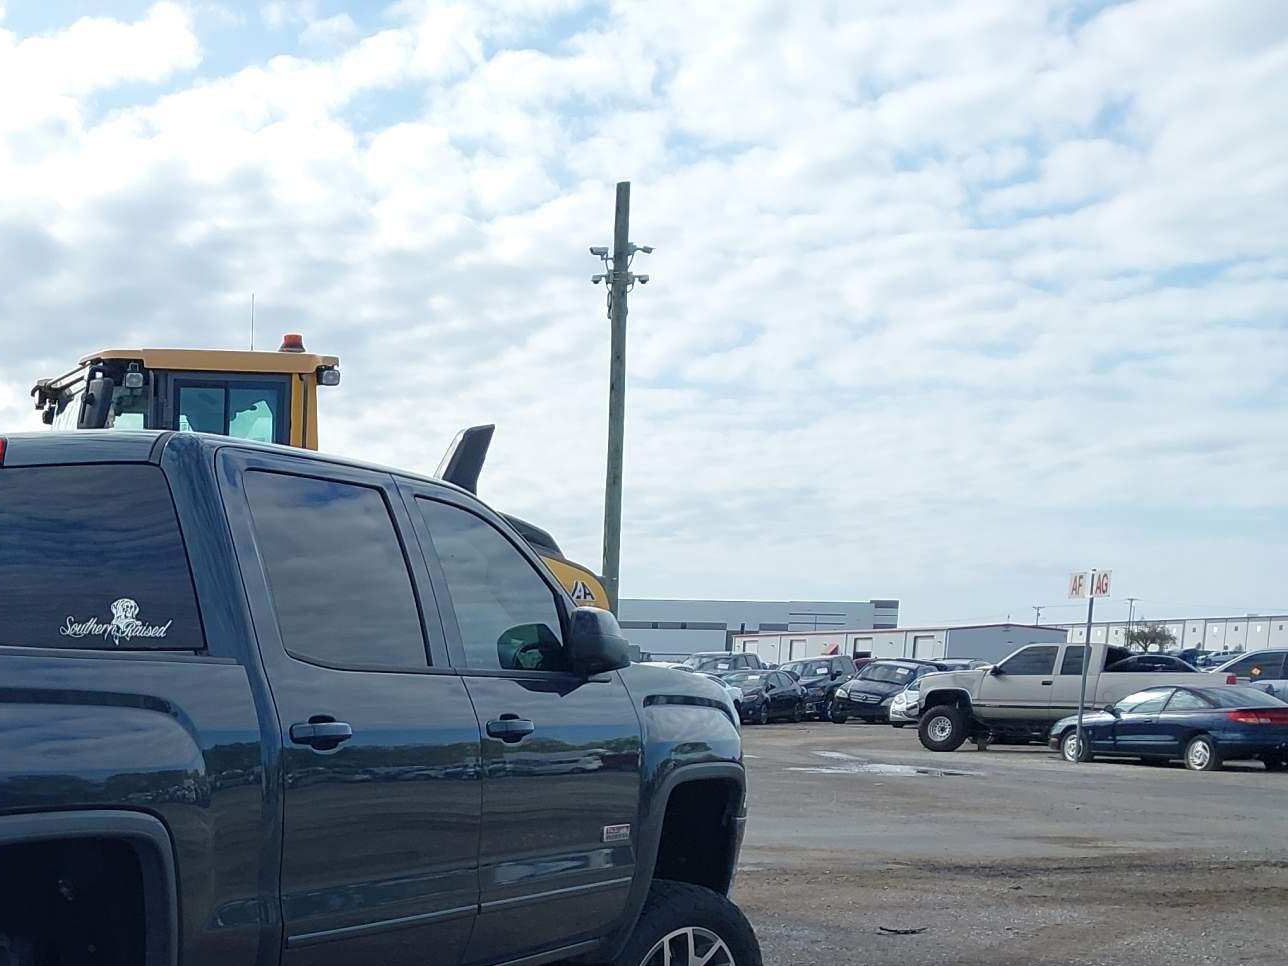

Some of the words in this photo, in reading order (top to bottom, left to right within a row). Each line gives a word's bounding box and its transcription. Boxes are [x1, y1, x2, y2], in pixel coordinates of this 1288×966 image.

[1095, 572, 1109, 595] AG
[59, 615, 117, 640] Southern
[121, 619, 173, 640] Raised
